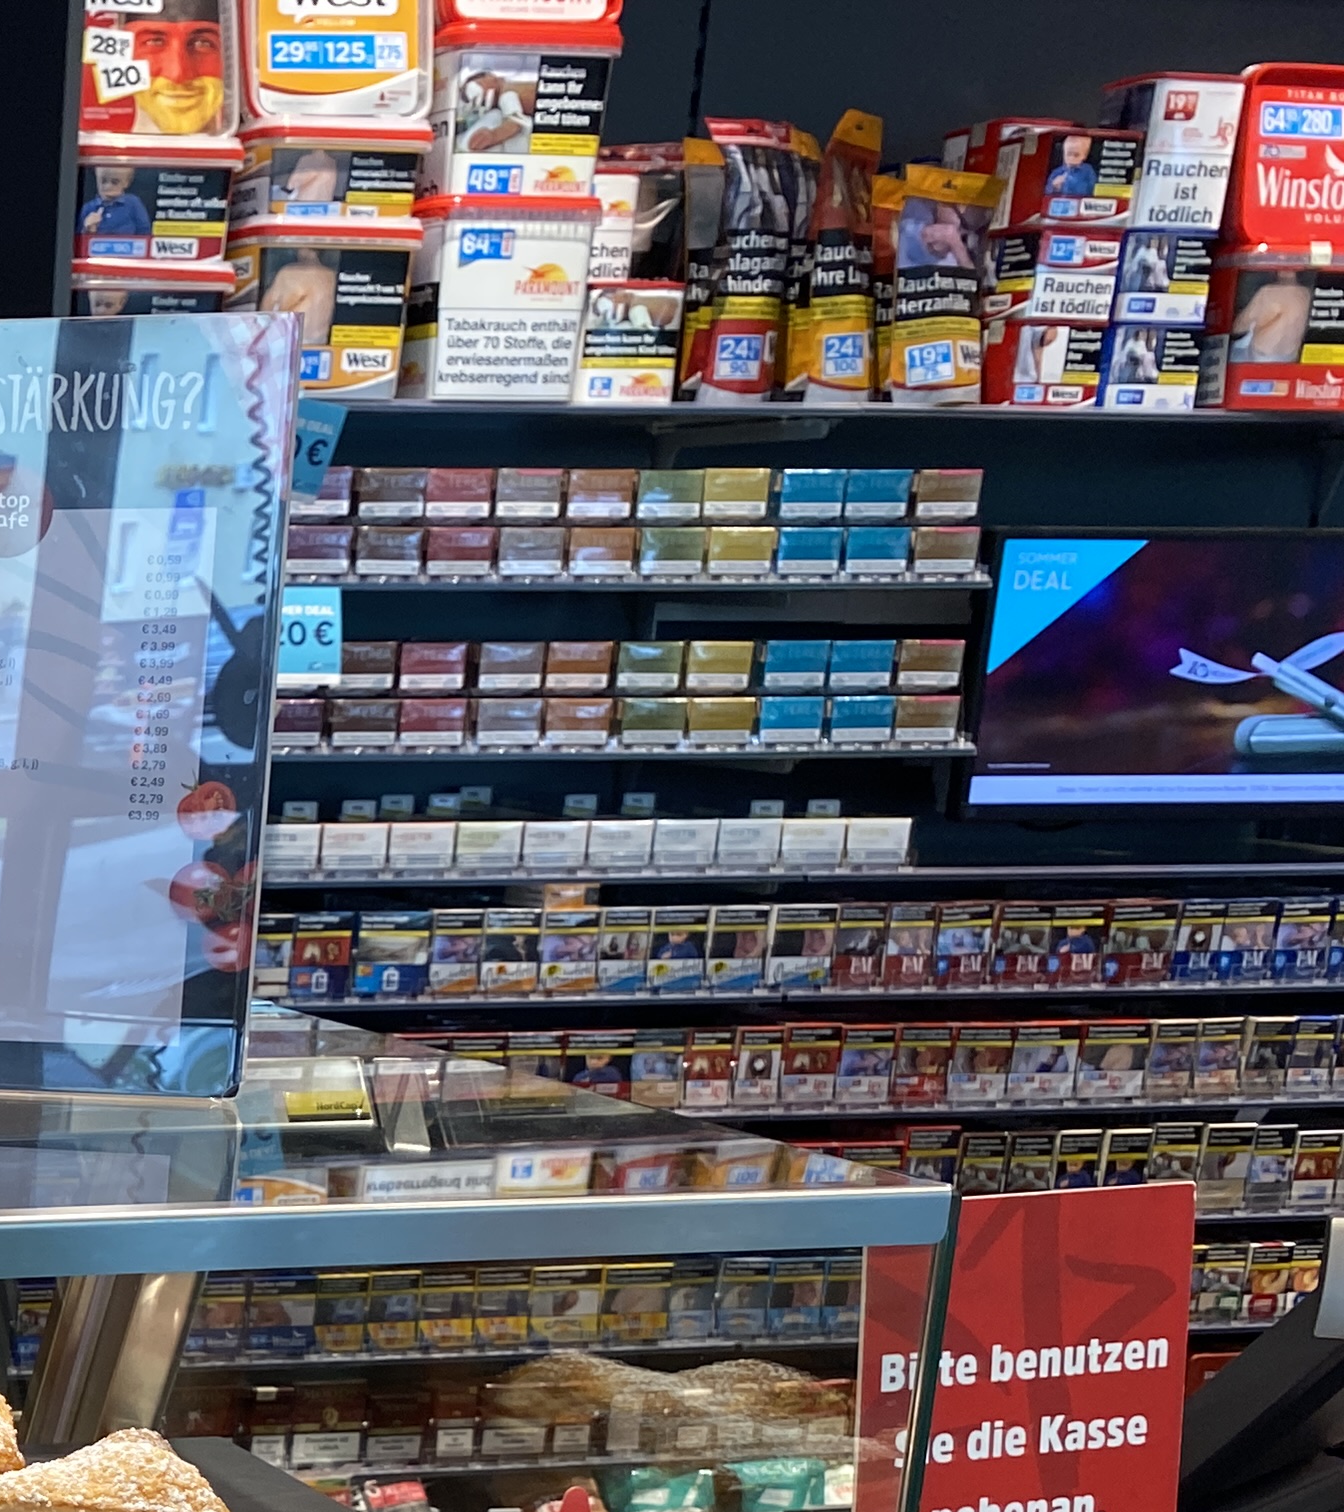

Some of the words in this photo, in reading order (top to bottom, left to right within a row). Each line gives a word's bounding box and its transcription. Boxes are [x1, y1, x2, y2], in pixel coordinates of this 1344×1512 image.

[1146, 159, 1228, 177] Rauchen
[1174, 184, 1198, 200] ist
[1149, 207, 1213, 224] tödlich
[1044, 277, 1112, 295] Rauchen
[1035, 298, 1055, 313] ist
[446, 318, 527, 331] Tabakrauch
[447, 336, 479, 349] über
[484, 336, 498, 348] 70
[551, 336, 572, 349] die
[346, 351, 388, 369] West
[447, 354, 568, 366] erwiesenermaßen
[438, 371, 537, 386] krebserregend
[1014, 571, 1071, 590] DEAL
[880, 1351, 977, 1392] Bite
[991, 1337, 1168, 1383] benutzen
[967, 1420, 1026, 1460] die
[1039, 1414, 1148, 1454] Kasse
